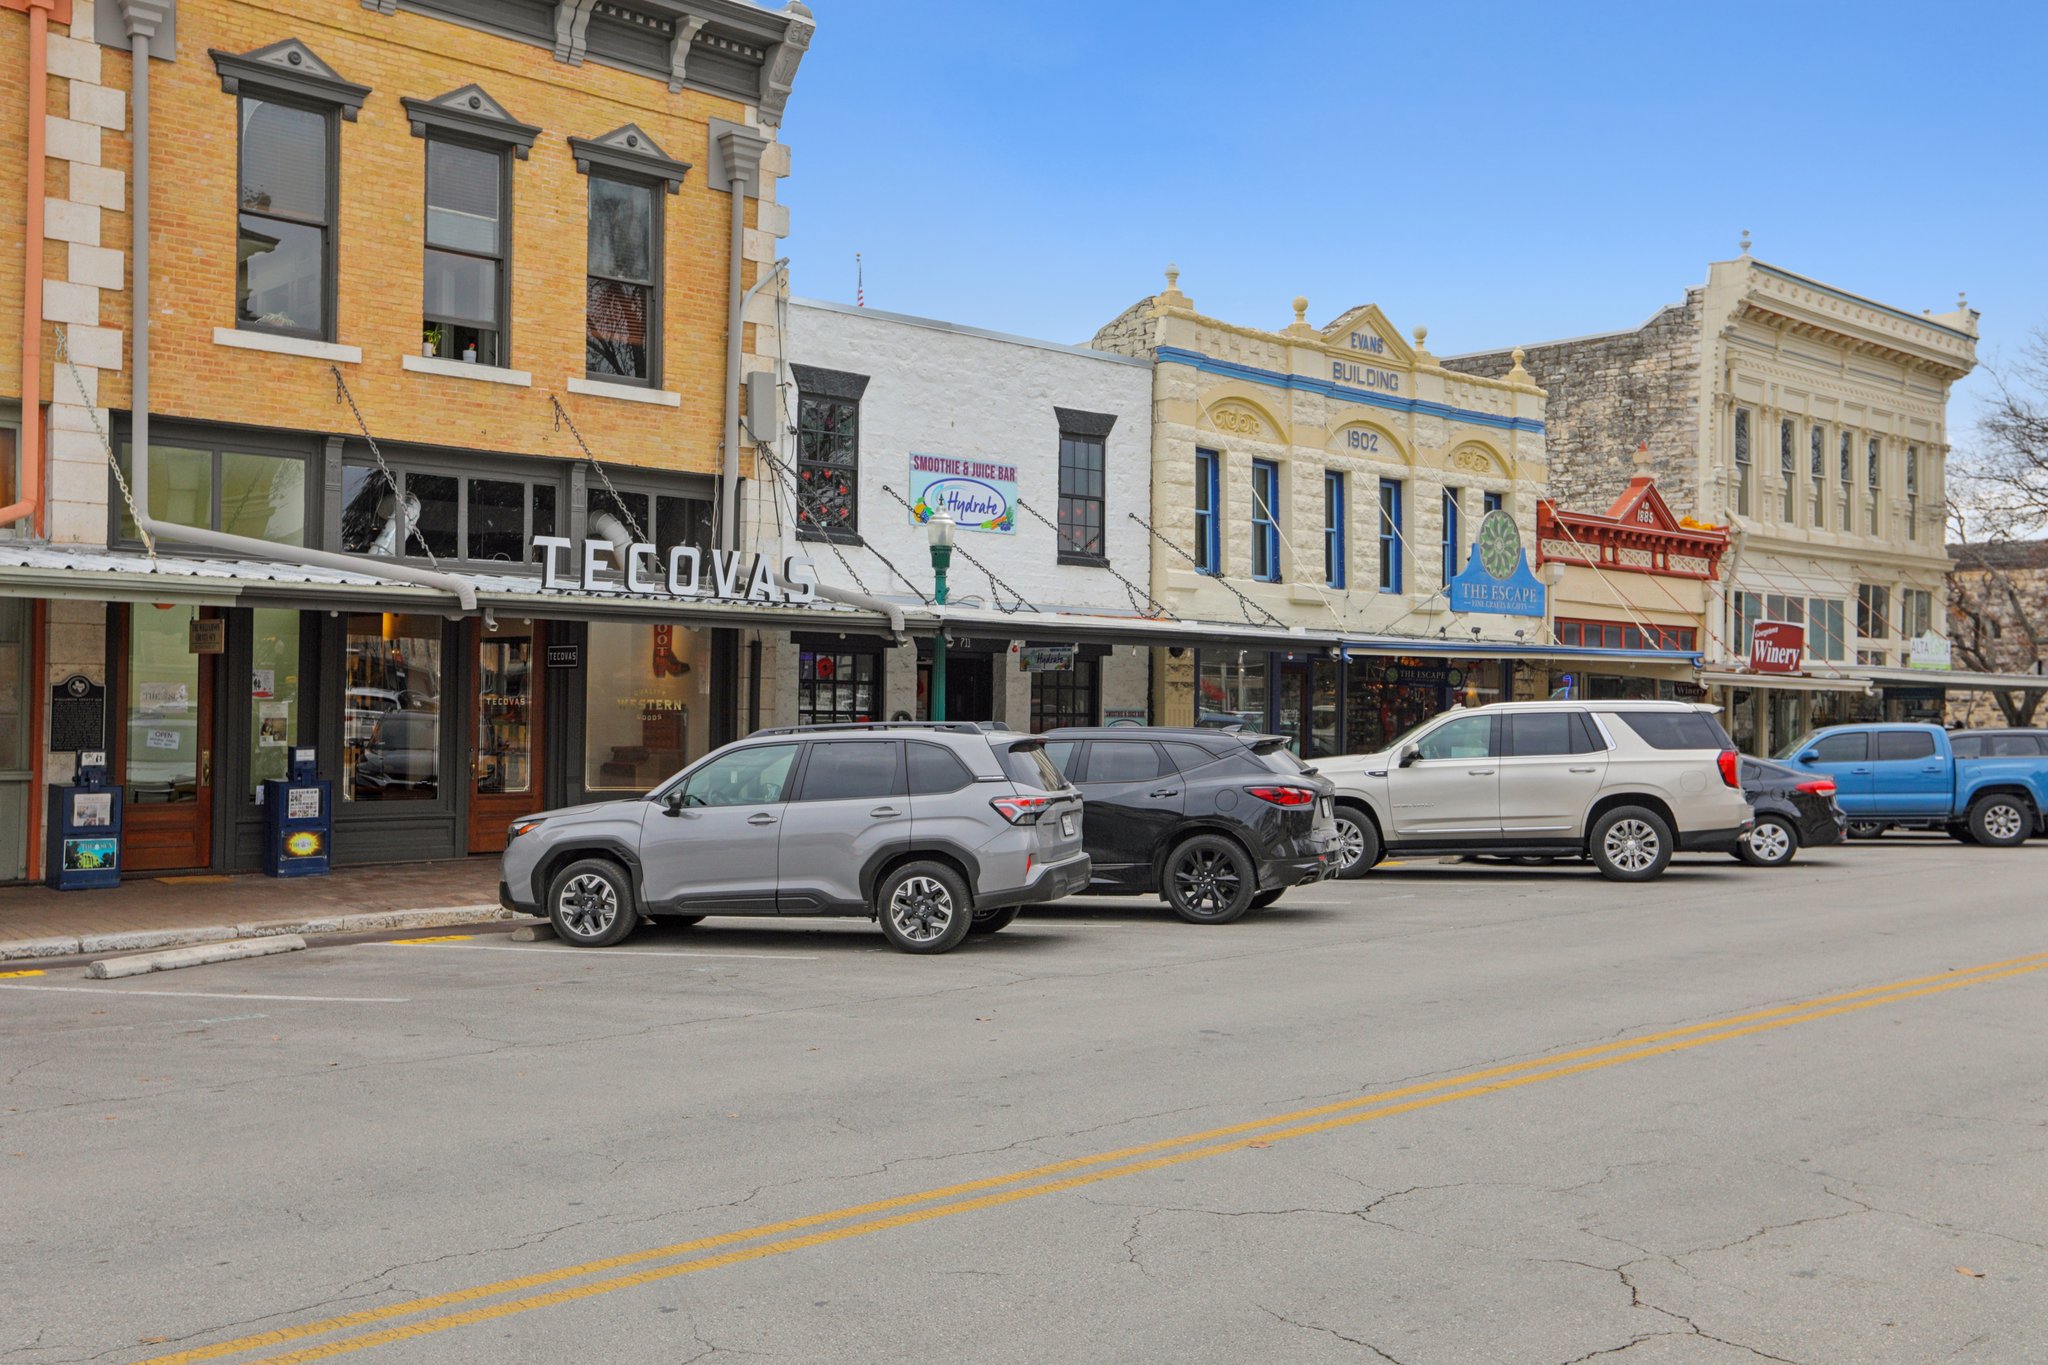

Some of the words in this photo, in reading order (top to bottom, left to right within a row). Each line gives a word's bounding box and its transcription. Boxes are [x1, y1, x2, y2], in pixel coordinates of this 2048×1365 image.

[1351, 332, 1383, 353] EVANS
[1333, 362, 1399, 391] BUILDING
[1347, 430, 1378, 452] 1902
[913, 456, 960, 475] SMOOTHIE
[963, 462, 969, 476] &
[972, 463, 996, 479] JUICE
[998, 467, 1015, 482] BAR
[947, 491, 998, 521] Hydrate
[1637, 509, 1654, 524] 1885
[531, 536, 816, 604] TECOVAS
[1461, 583, 1488, 600] THE
[1491, 585, 1537, 603] ESCAPE
[960, 637, 971, 648] 711
[549, 652, 576, 661] TECOVAS
[1037, 652, 1064, 669] Hydrate
[1754, 640, 1800, 671] Winery
[1417, 671, 1445, 679] ESCAPE
[486, 697, 526, 706] TECOVAS
[617, 699, 682, 711] WESTERN
[155, 731, 173, 739] OPEN
